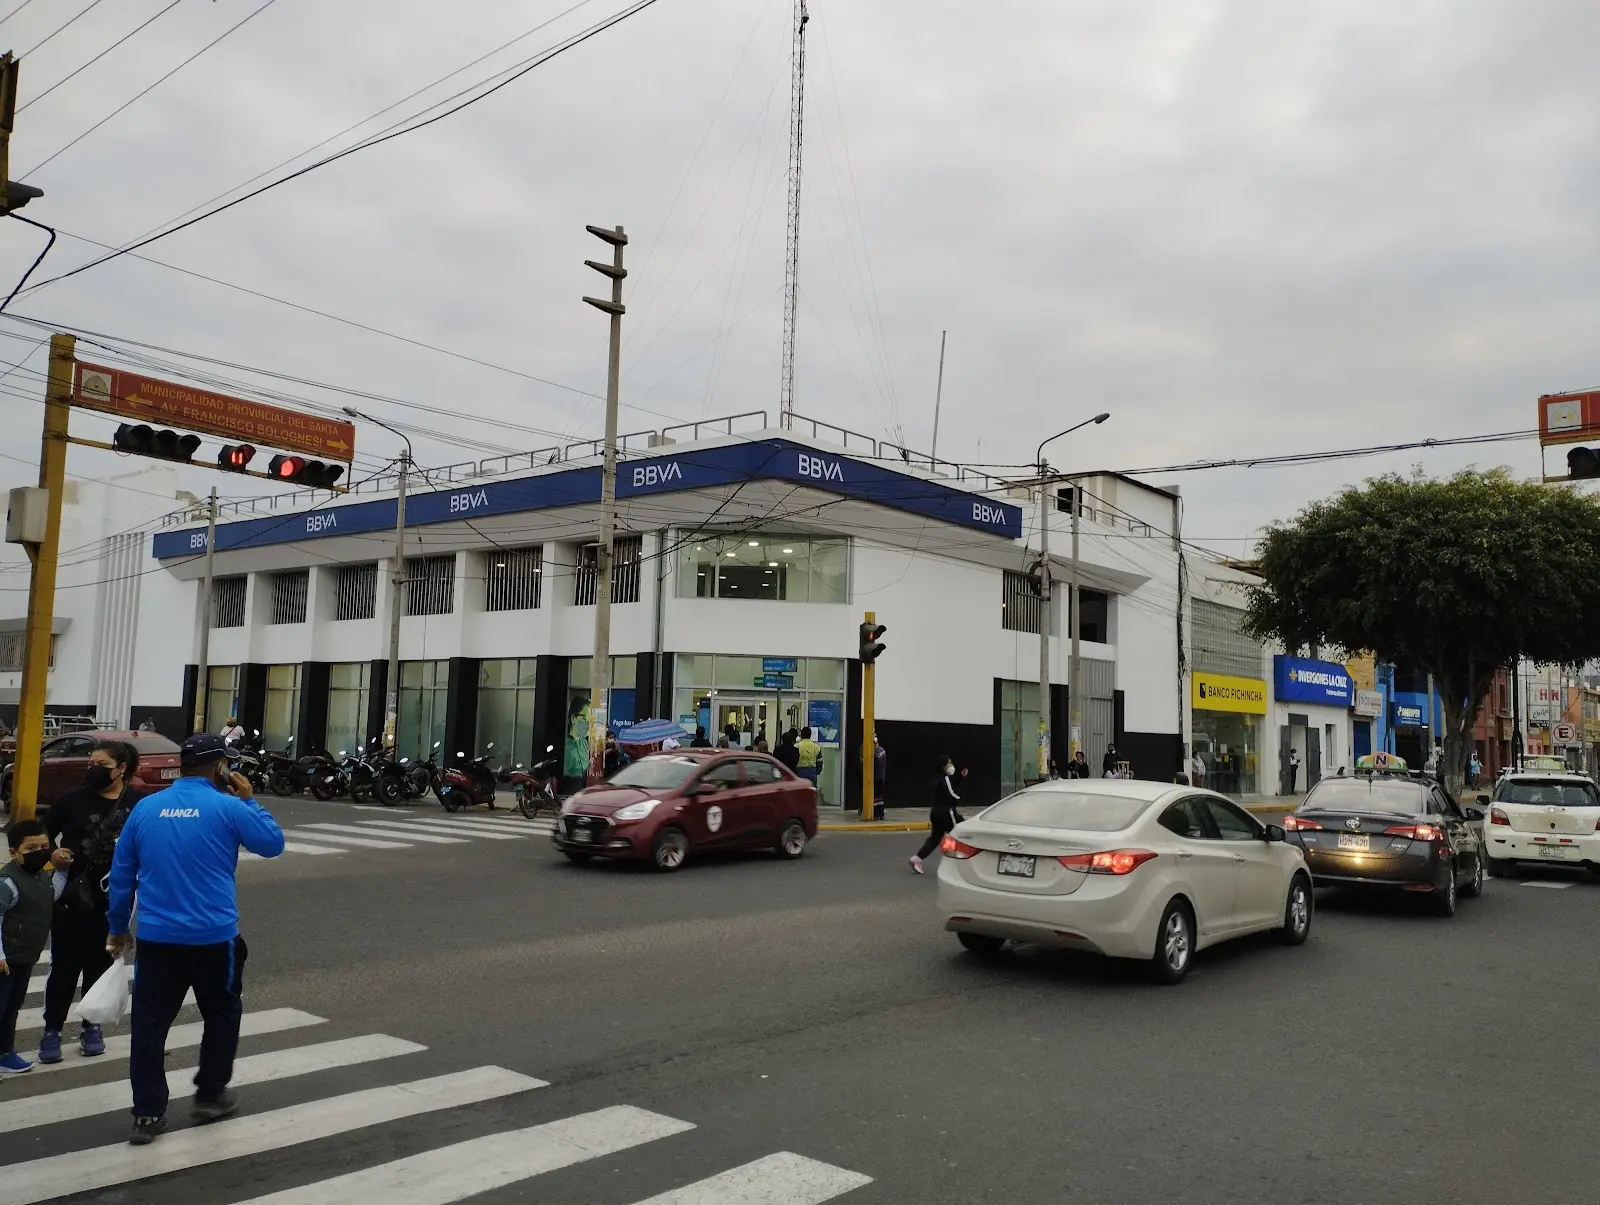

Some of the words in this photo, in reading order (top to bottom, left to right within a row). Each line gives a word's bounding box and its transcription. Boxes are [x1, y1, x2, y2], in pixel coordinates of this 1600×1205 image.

[141, 382, 224, 410] MUNICIPALIDAD
[227, 402, 286, 425] PROVINCIAL
[288, 416, 307, 429] DEL
[308, 421, 340, 436] SANTA
[183, 407, 254, 433] FRANCISCO
[632, 462, 683, 487] BBVA
[798, 453, 844, 482] BBVA
[450, 489, 488, 513] BBVA
[306, 512, 337, 533] BBVA
[972, 503, 1006, 525] BBVA
[190, 533, 216, 549] BBV
[1297, 670, 1328, 686] INVERSIONES
[1328, 674, 1336, 687] LA
[1335, 675, 1348, 688] CRUZ
[1208, 687, 1230, 699] BANCO
[1231, 688, 1263, 702] PICHINCHA
[1558, 728, 1570, 738] E
[1375, 754, 1387, 766] N
[159, 808, 200, 818] ALIANZA
